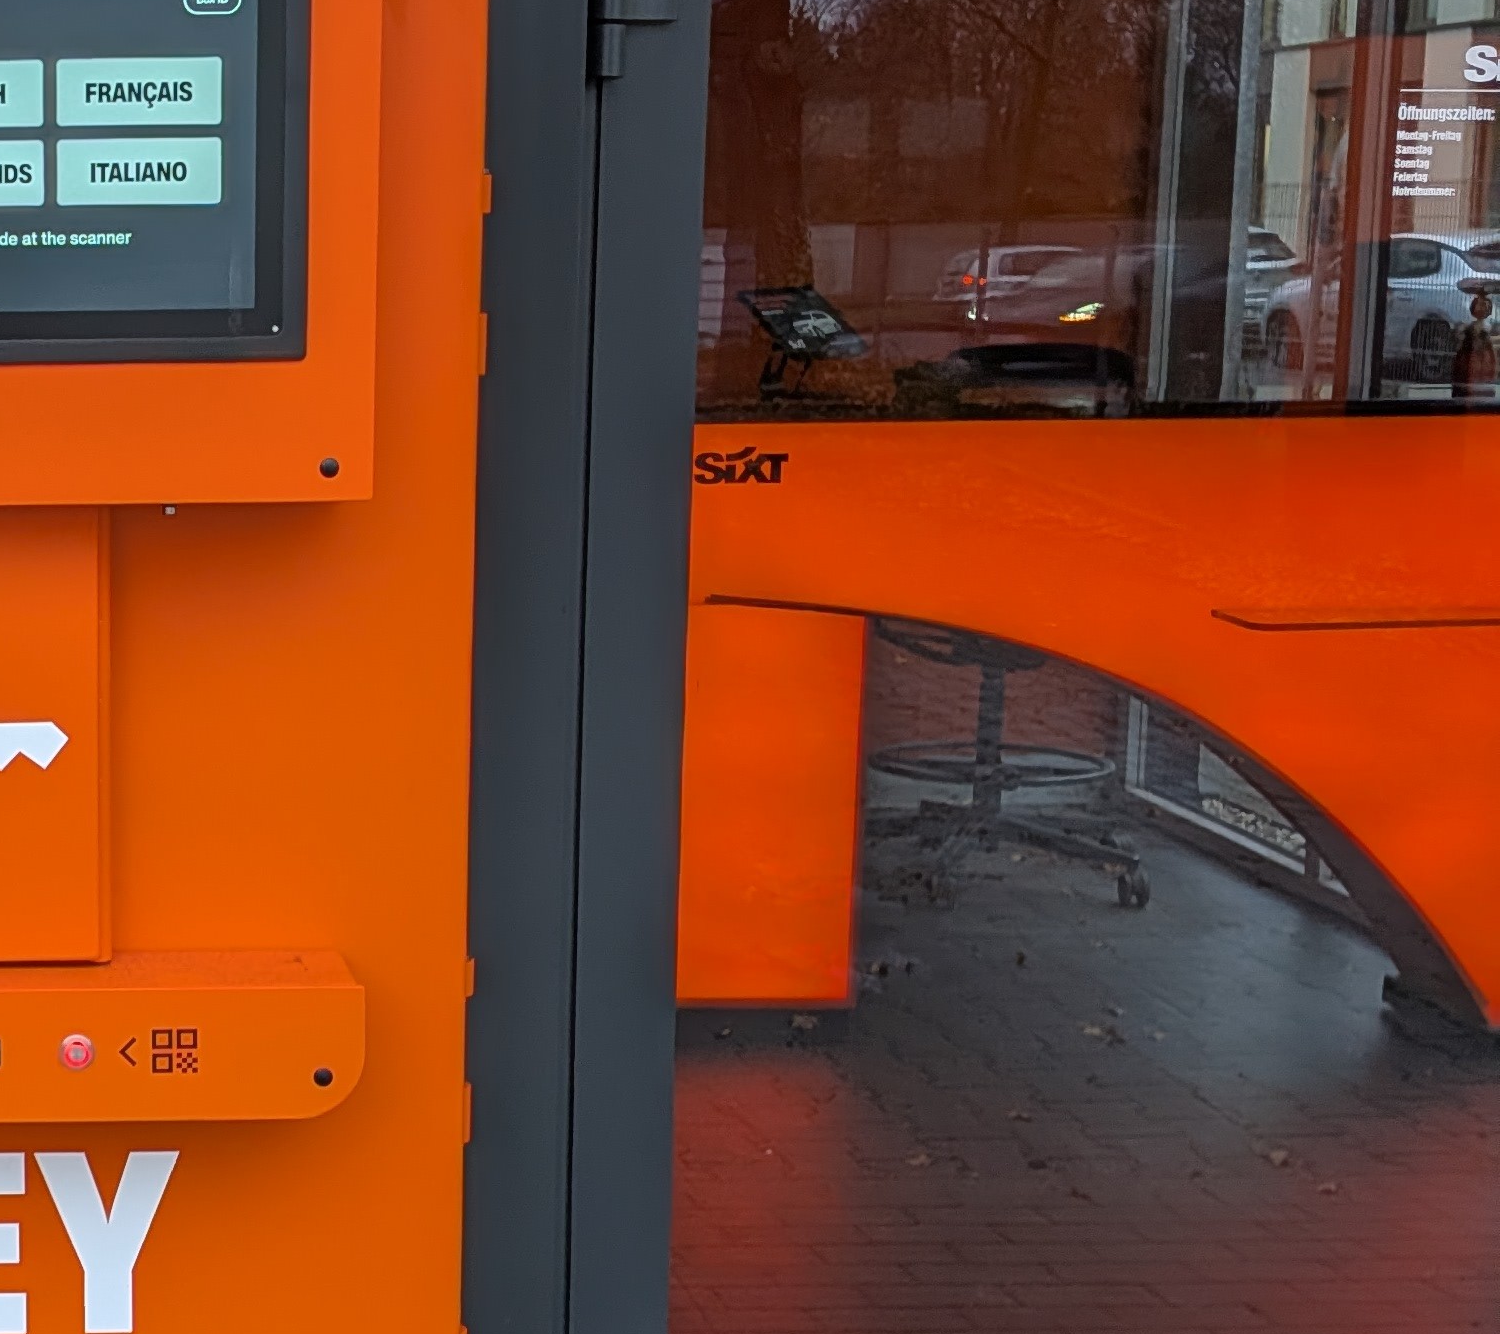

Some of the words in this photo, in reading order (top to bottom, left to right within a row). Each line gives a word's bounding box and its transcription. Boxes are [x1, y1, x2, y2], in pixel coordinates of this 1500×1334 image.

[85, 81, 194, 109] FRANÇAIS
[1397, 102, 1496, 122] Öffnungszeiten:
[89, 161, 188, 184] ITALIANO
[22, 234, 37, 246] at
[41, 232, 66, 246] the
[70, 232, 132, 245] scanner
